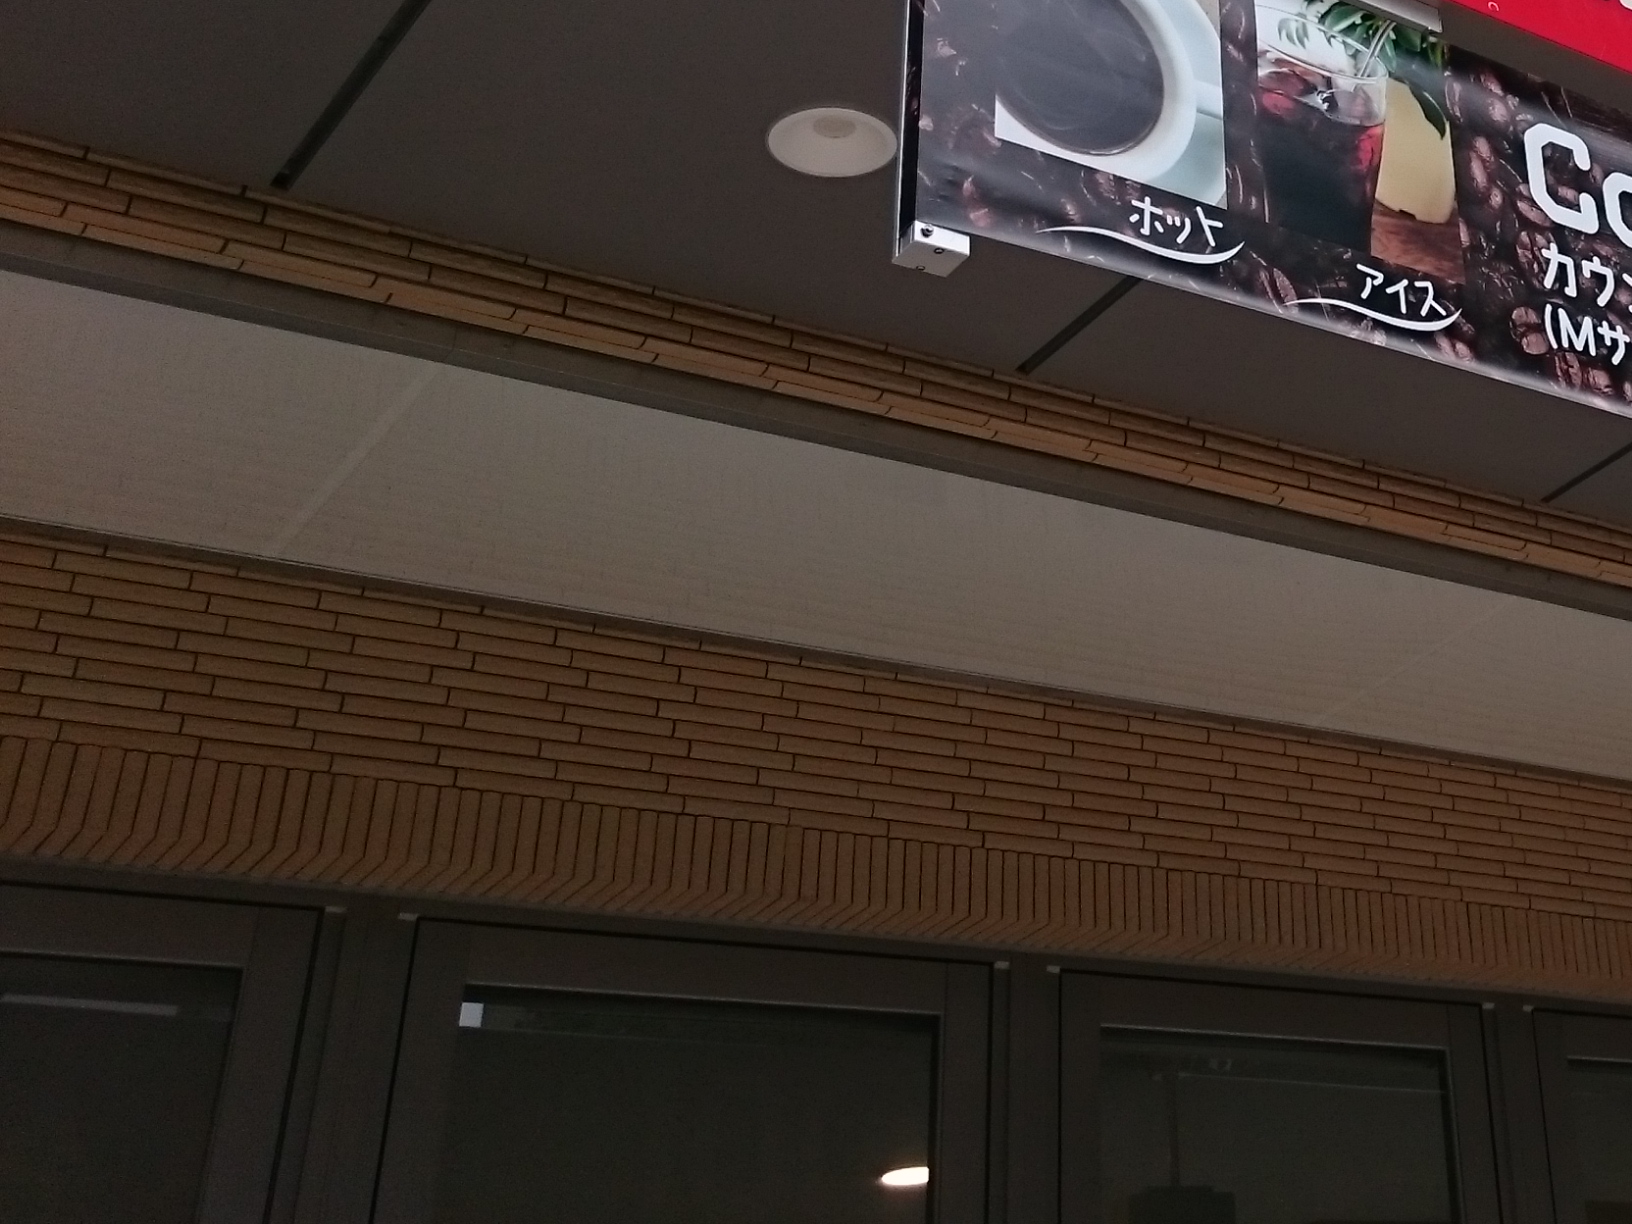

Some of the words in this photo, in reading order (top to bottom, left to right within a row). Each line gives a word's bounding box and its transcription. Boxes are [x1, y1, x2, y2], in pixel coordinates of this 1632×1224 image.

[1129, 196, 1223, 249] ホット
[1356, 264, 1447, 318] アイス
